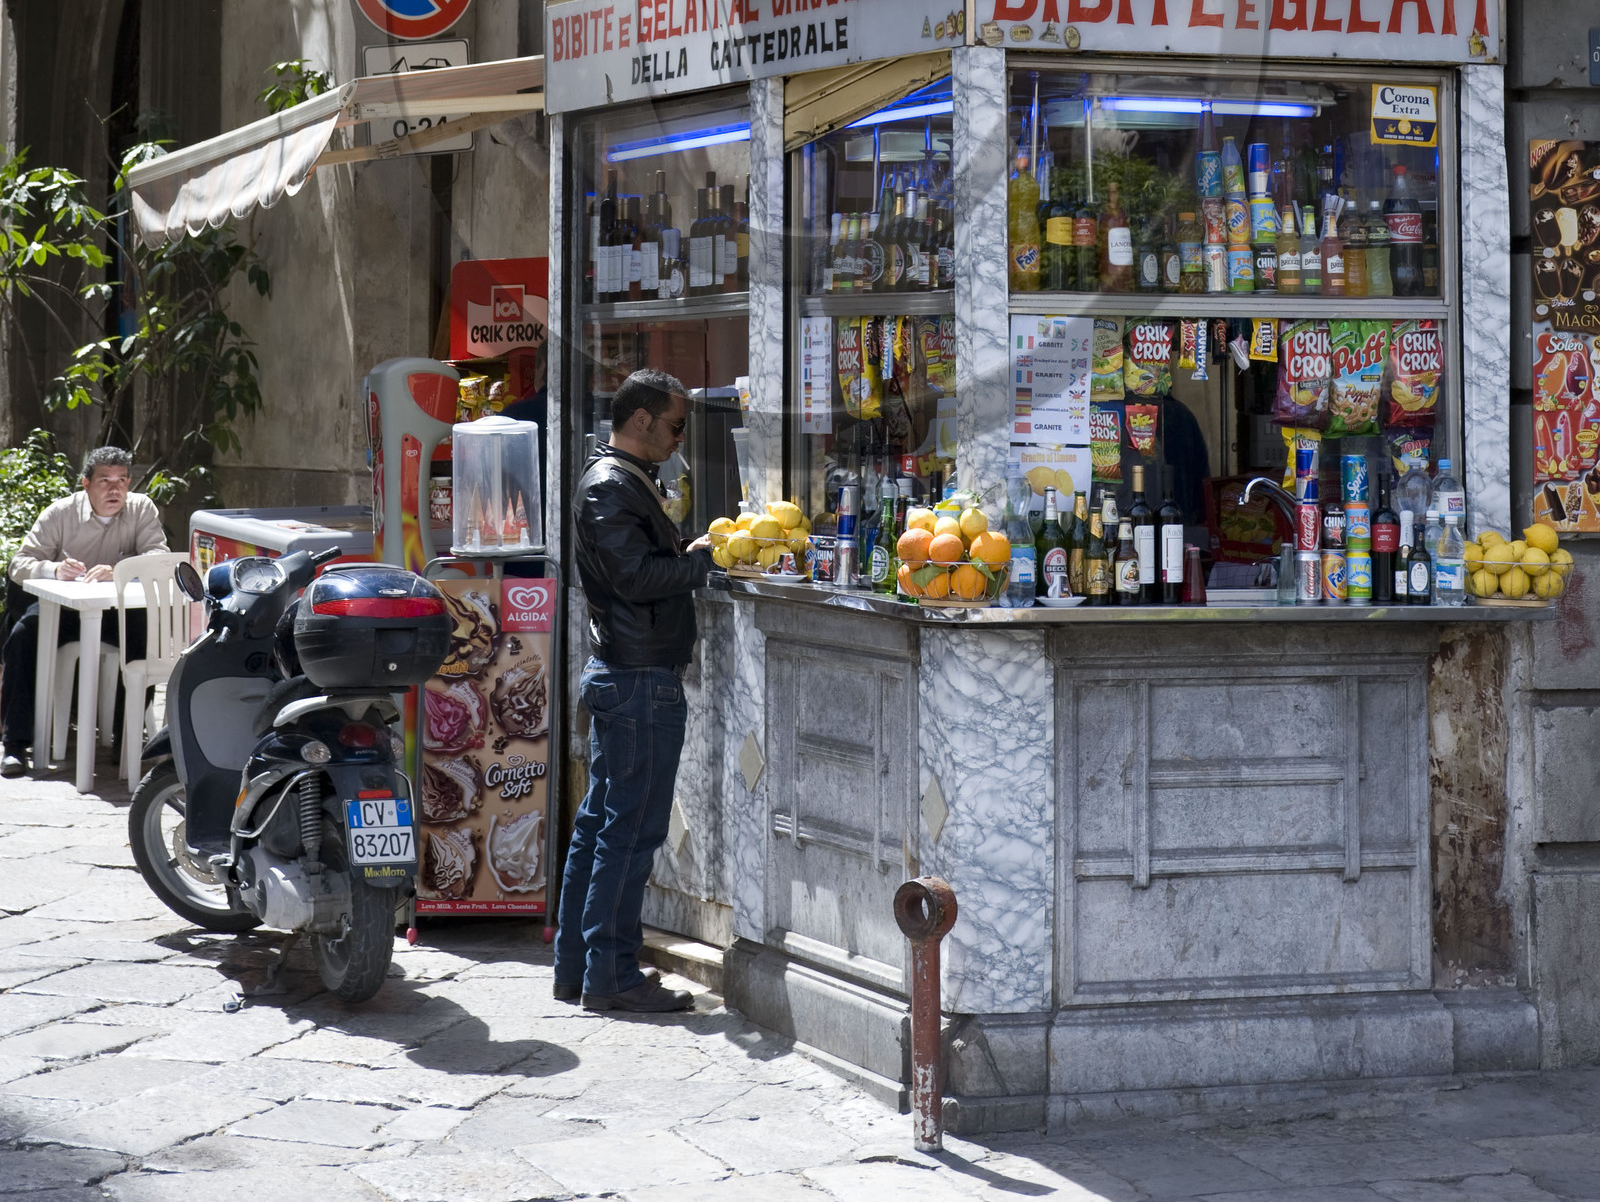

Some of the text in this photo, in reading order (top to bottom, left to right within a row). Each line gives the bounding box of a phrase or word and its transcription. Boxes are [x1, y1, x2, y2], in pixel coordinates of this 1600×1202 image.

[552, 5, 615, 62] BIBITE
[631, 16, 848, 85] DELLA CATTEDRALE
[1380, 87, 1430, 106] Corona
[1392, 104, 1420, 115] Extra
[471, 323, 544, 343] CRIK CROK
[1135, 324, 1170, 342] CRIK
[1403, 333, 1436, 351] CRIK
[1133, 342, 1171, 360] CROK
[1545, 336, 1583, 354] Solero
[1332, 329, 1386, 380] Puff
[1401, 352, 1440, 372] CROK
[1034, 423, 1063, 431] GRANITE
[1090, 413, 1114, 427] CRIK
[1090, 426, 1118, 440] CROK
[507, 612, 547, 622] ALGIDA
[439, 660, 469, 673] ovità
[486, 762, 545, 787] Cornetto
[501, 778, 531, 798] Soft
[362, 802, 384, 826] CV
[354, 832, 411, 858] 83207
